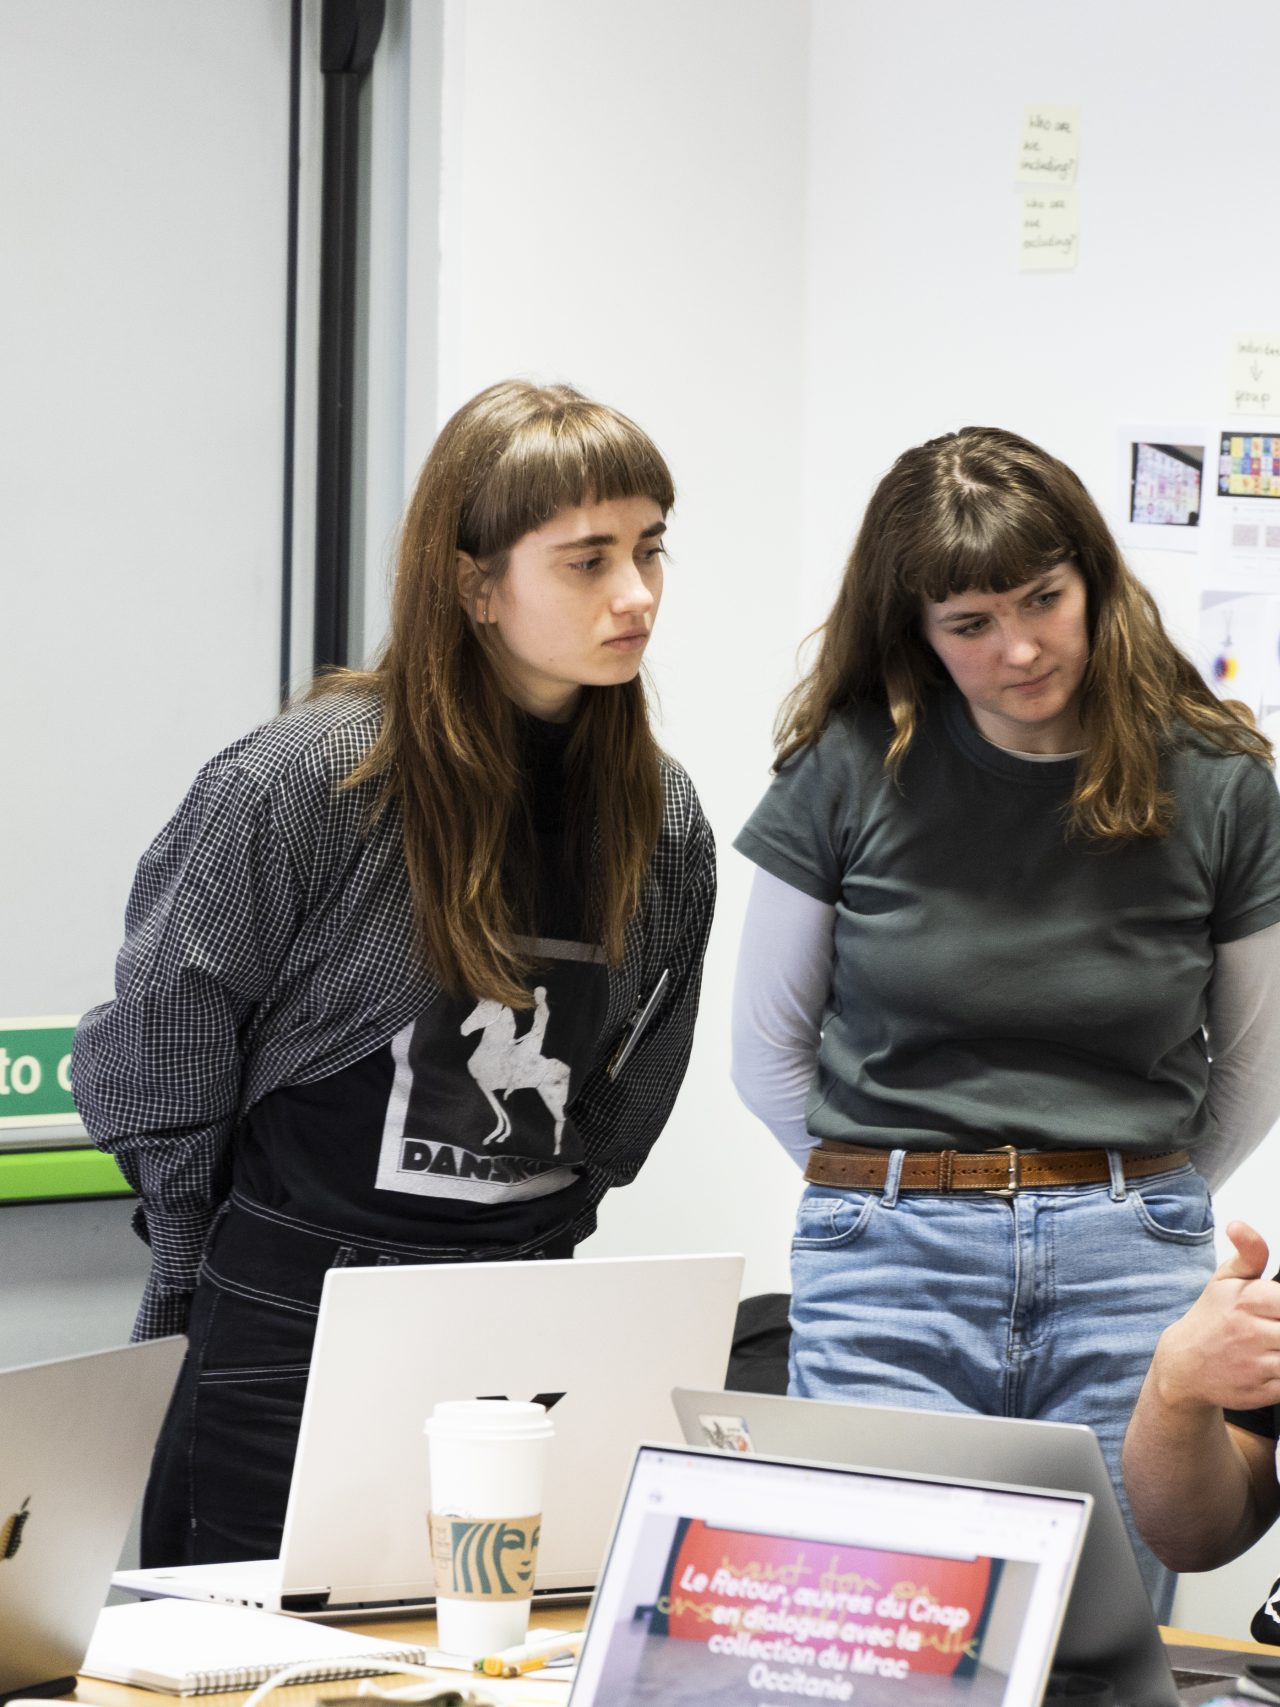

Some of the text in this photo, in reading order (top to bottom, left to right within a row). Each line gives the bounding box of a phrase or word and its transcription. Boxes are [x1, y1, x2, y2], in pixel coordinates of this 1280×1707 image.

[1023, 140, 1041, 151] we
[1235, 389, 1271, 410] group
[680, 1564, 708, 1593] Le
[876, 1593, 908, 1620] du
[909, 1596, 971, 1632] Cnap
[711, 1605, 740, 1626] en
[742, 1605, 838, 1642] dialogue
[840, 1623, 894, 1648] avec
[896, 1627, 922, 1653] la
[708, 1633, 910, 1680] collection du Mrac
[748, 1662, 854, 1702] Occitanie
